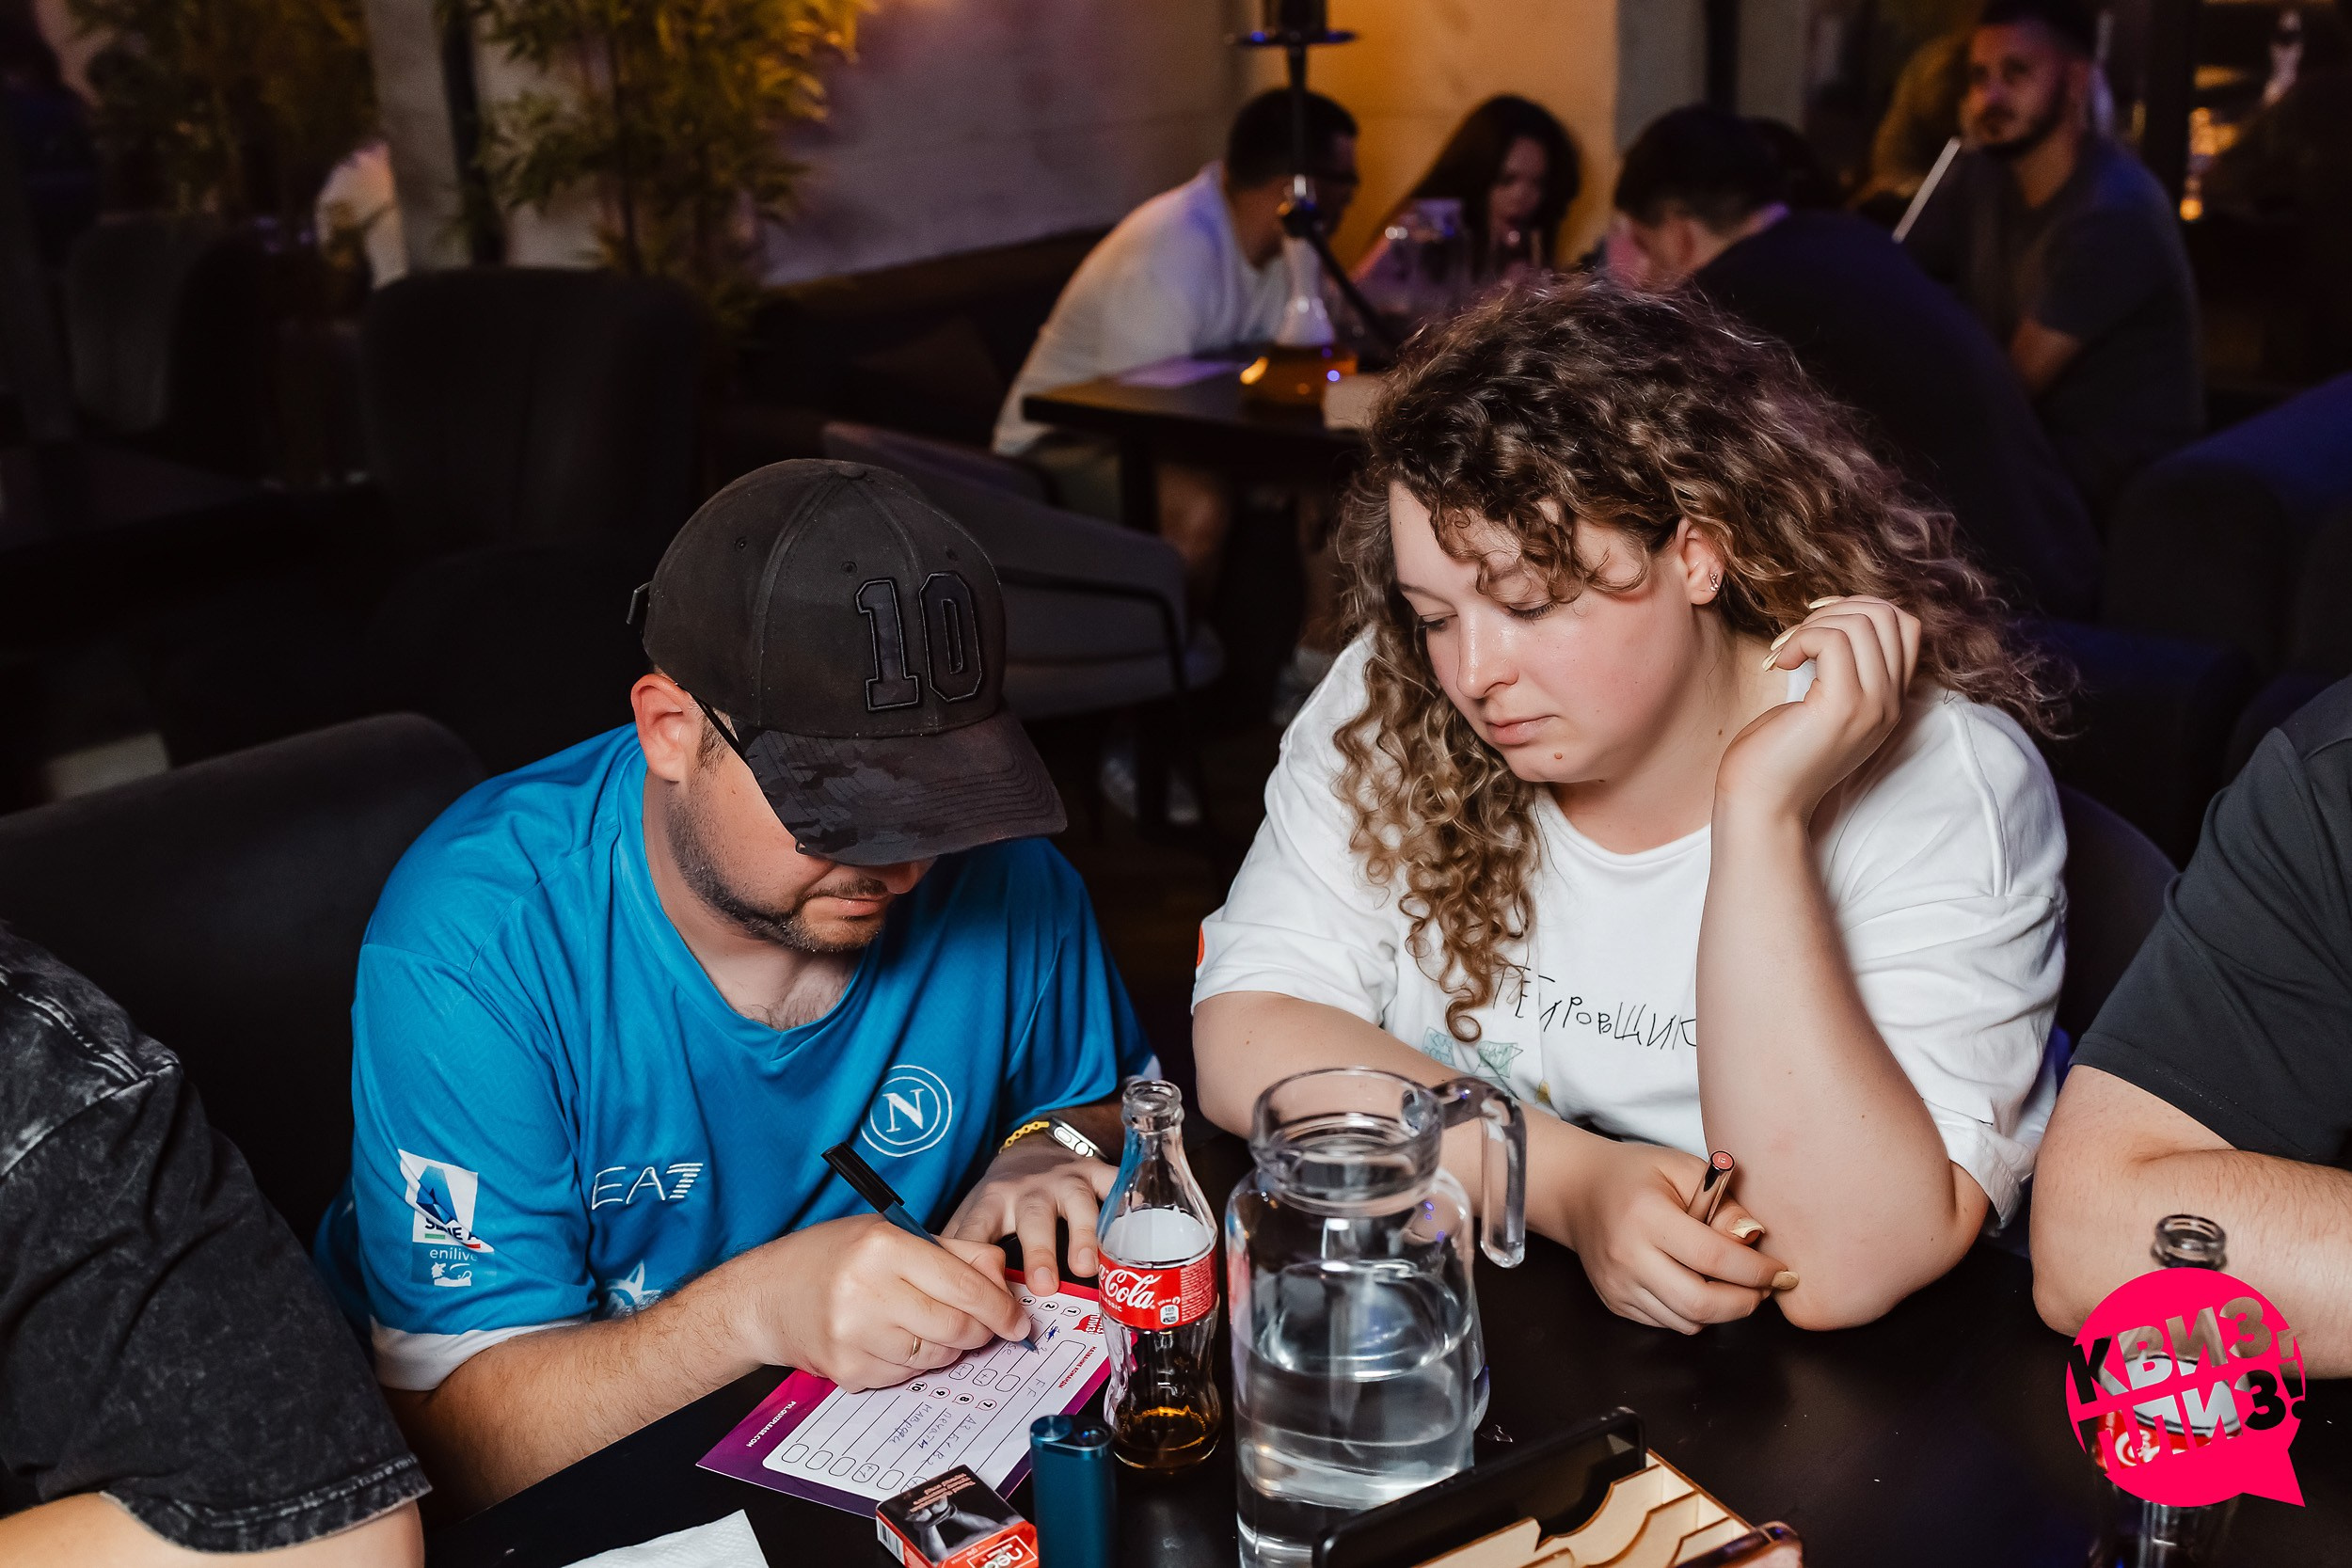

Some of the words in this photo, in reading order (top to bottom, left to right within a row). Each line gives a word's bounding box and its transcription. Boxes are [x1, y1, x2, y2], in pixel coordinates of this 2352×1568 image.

[854, 571, 982, 711] 10
[882, 1088, 925, 1133] N
[591, 1163, 704, 1211] EA7
[911, 1382, 924, 1392] 10
